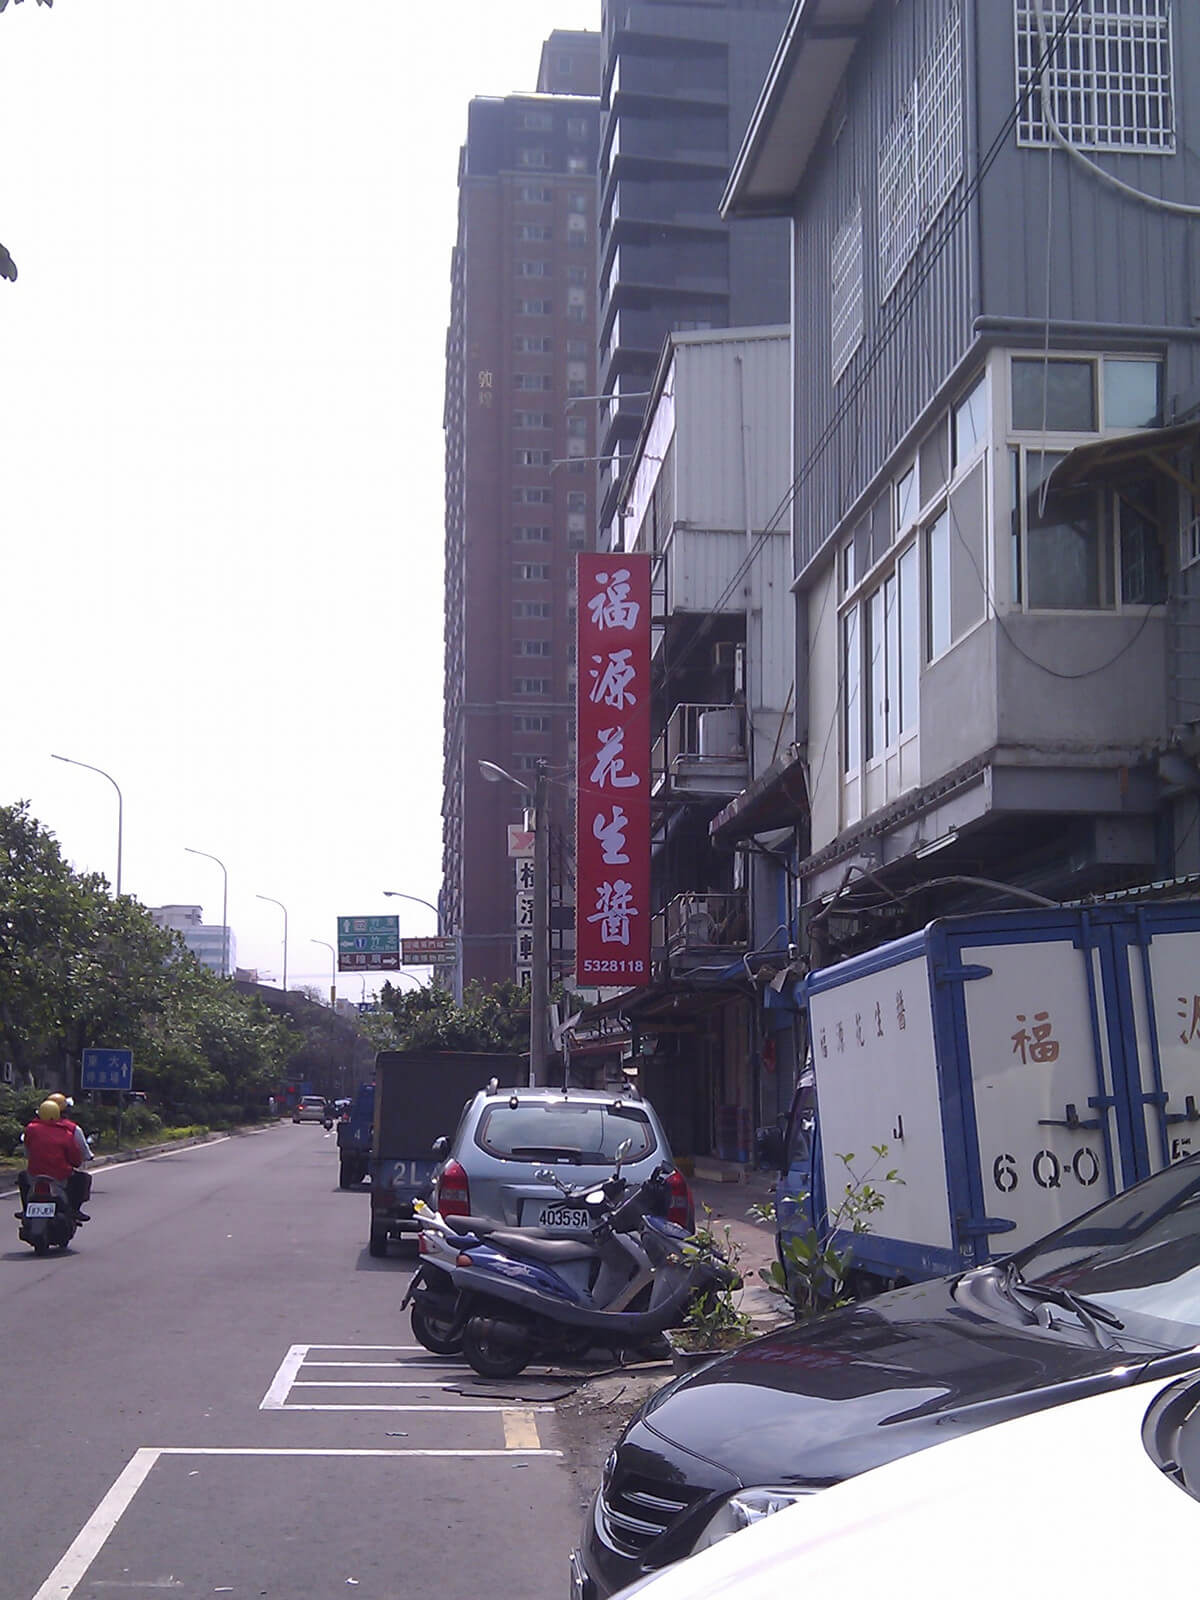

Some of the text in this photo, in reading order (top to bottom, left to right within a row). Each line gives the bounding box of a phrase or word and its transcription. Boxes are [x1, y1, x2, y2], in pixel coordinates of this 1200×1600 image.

[587, 568, 641, 947] 福源花生醬
[583, 960, 645, 973] 5328118
[1010, 1010, 1060, 1065] 福
